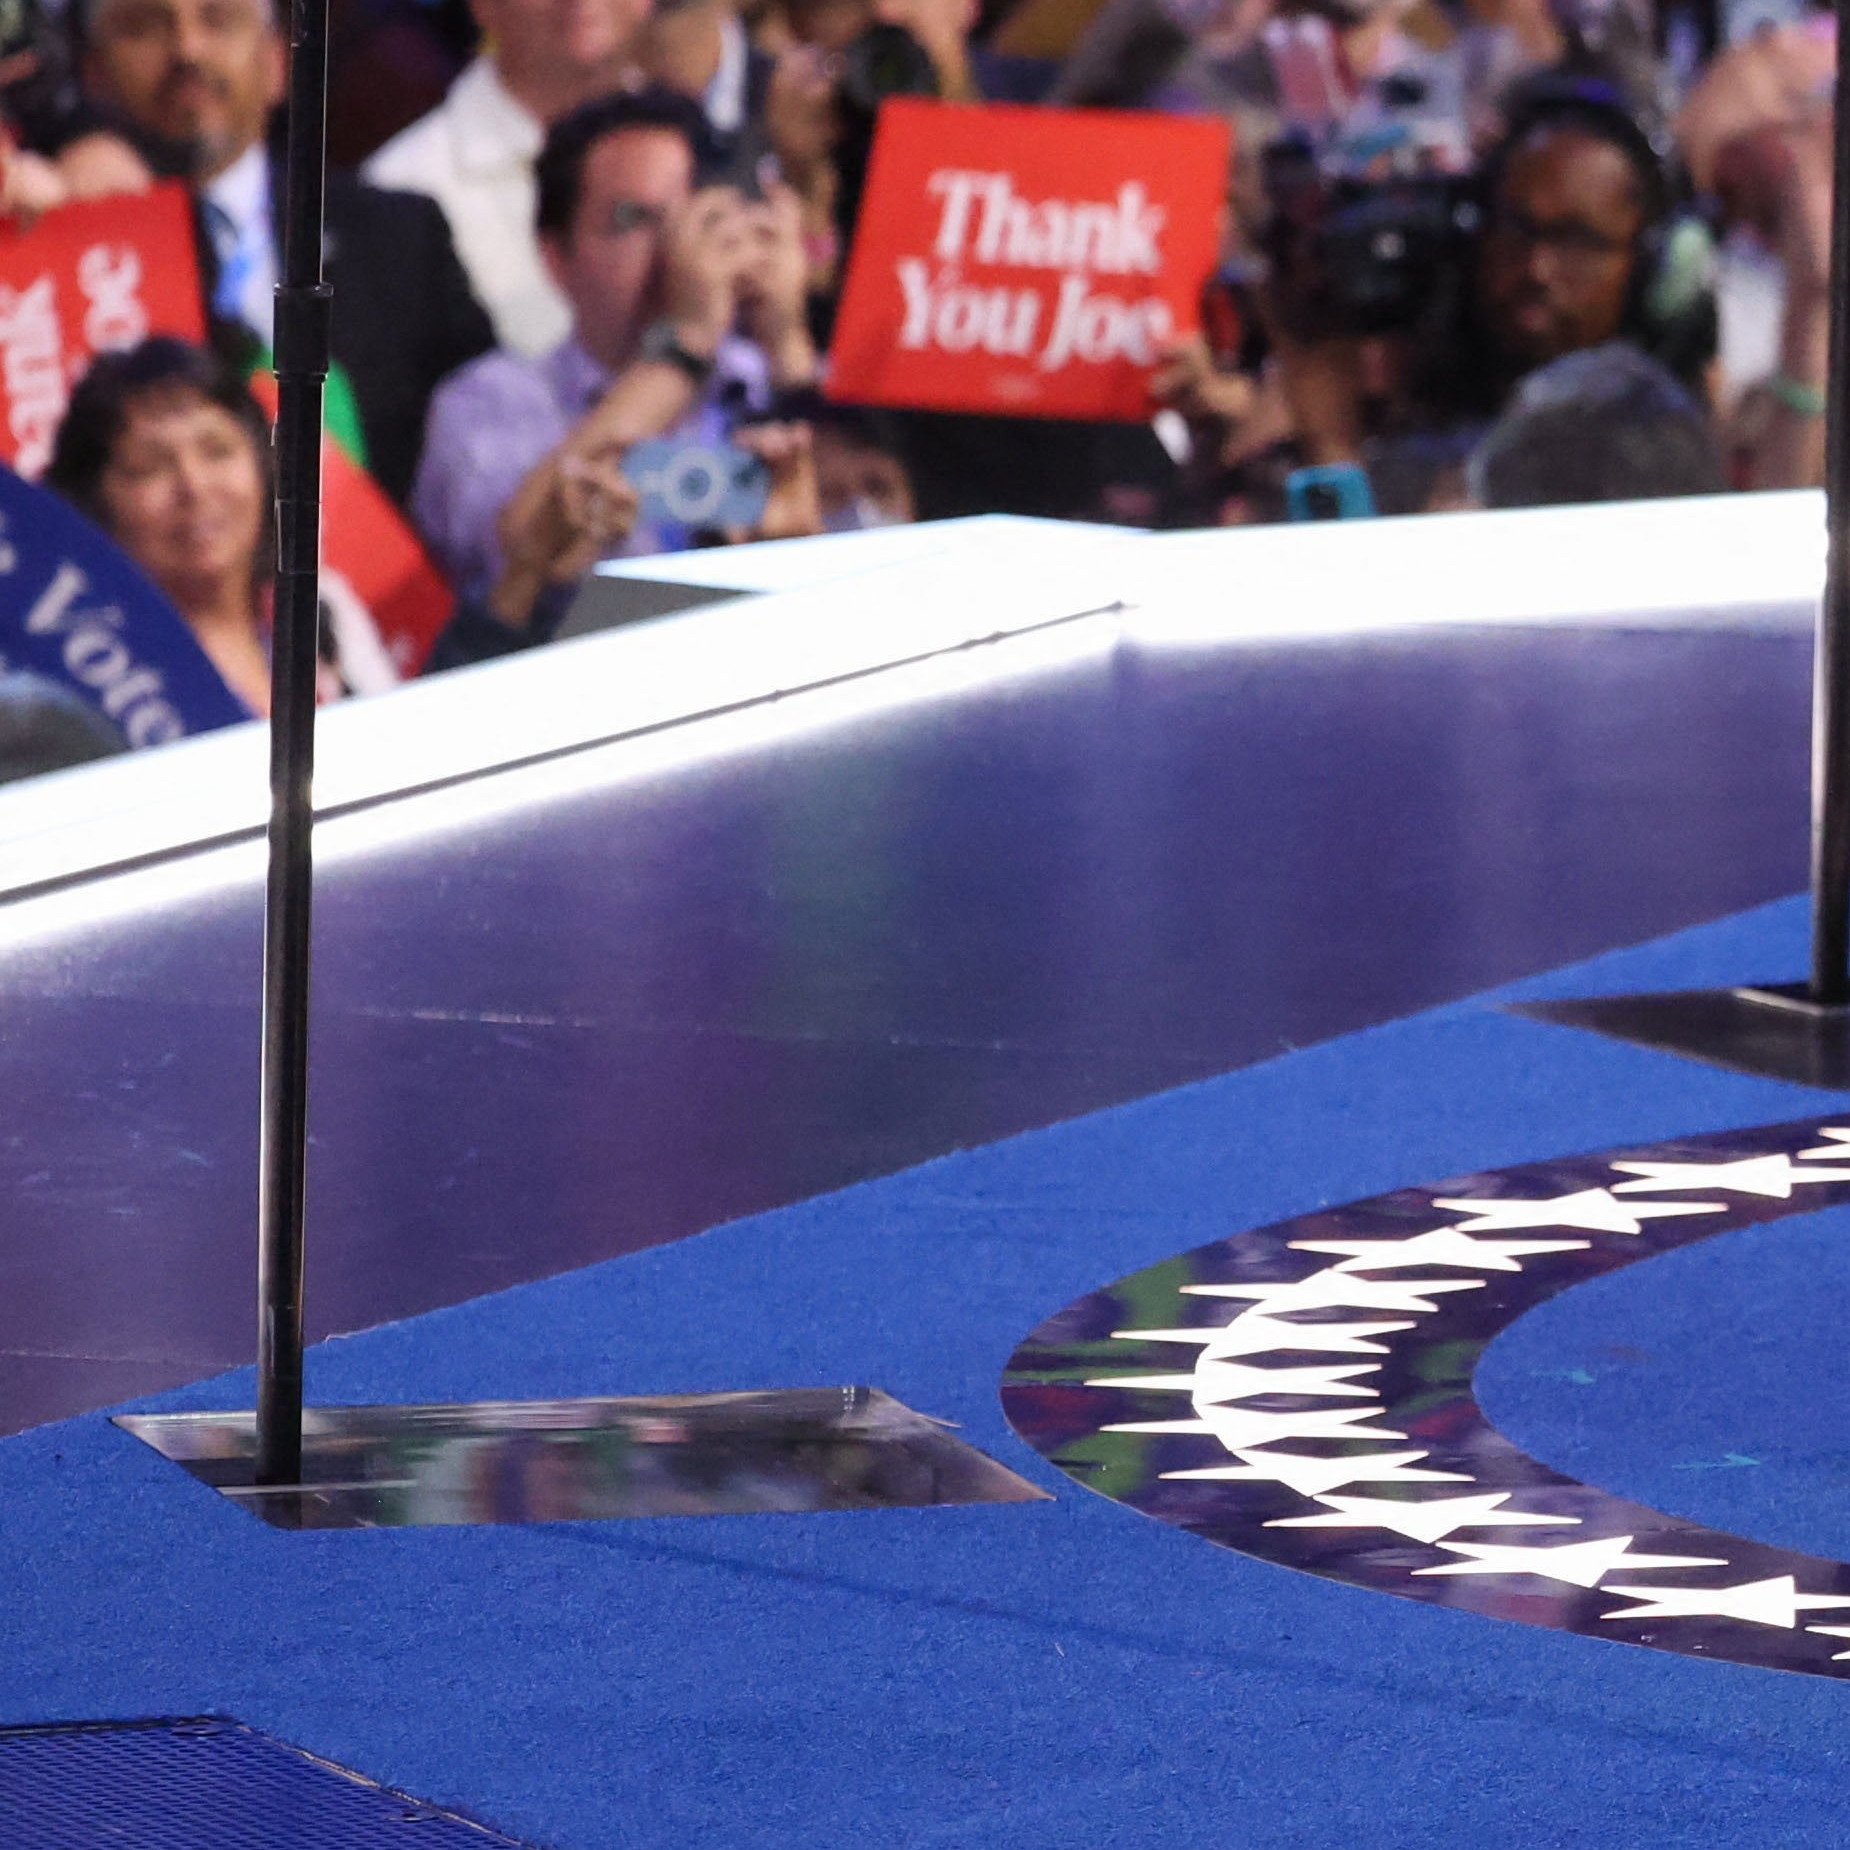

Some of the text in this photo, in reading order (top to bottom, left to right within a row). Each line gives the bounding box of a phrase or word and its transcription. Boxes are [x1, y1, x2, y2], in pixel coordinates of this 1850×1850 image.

[925, 166, 1168, 277] Thank
[895, 256, 1174, 372] You Joe
